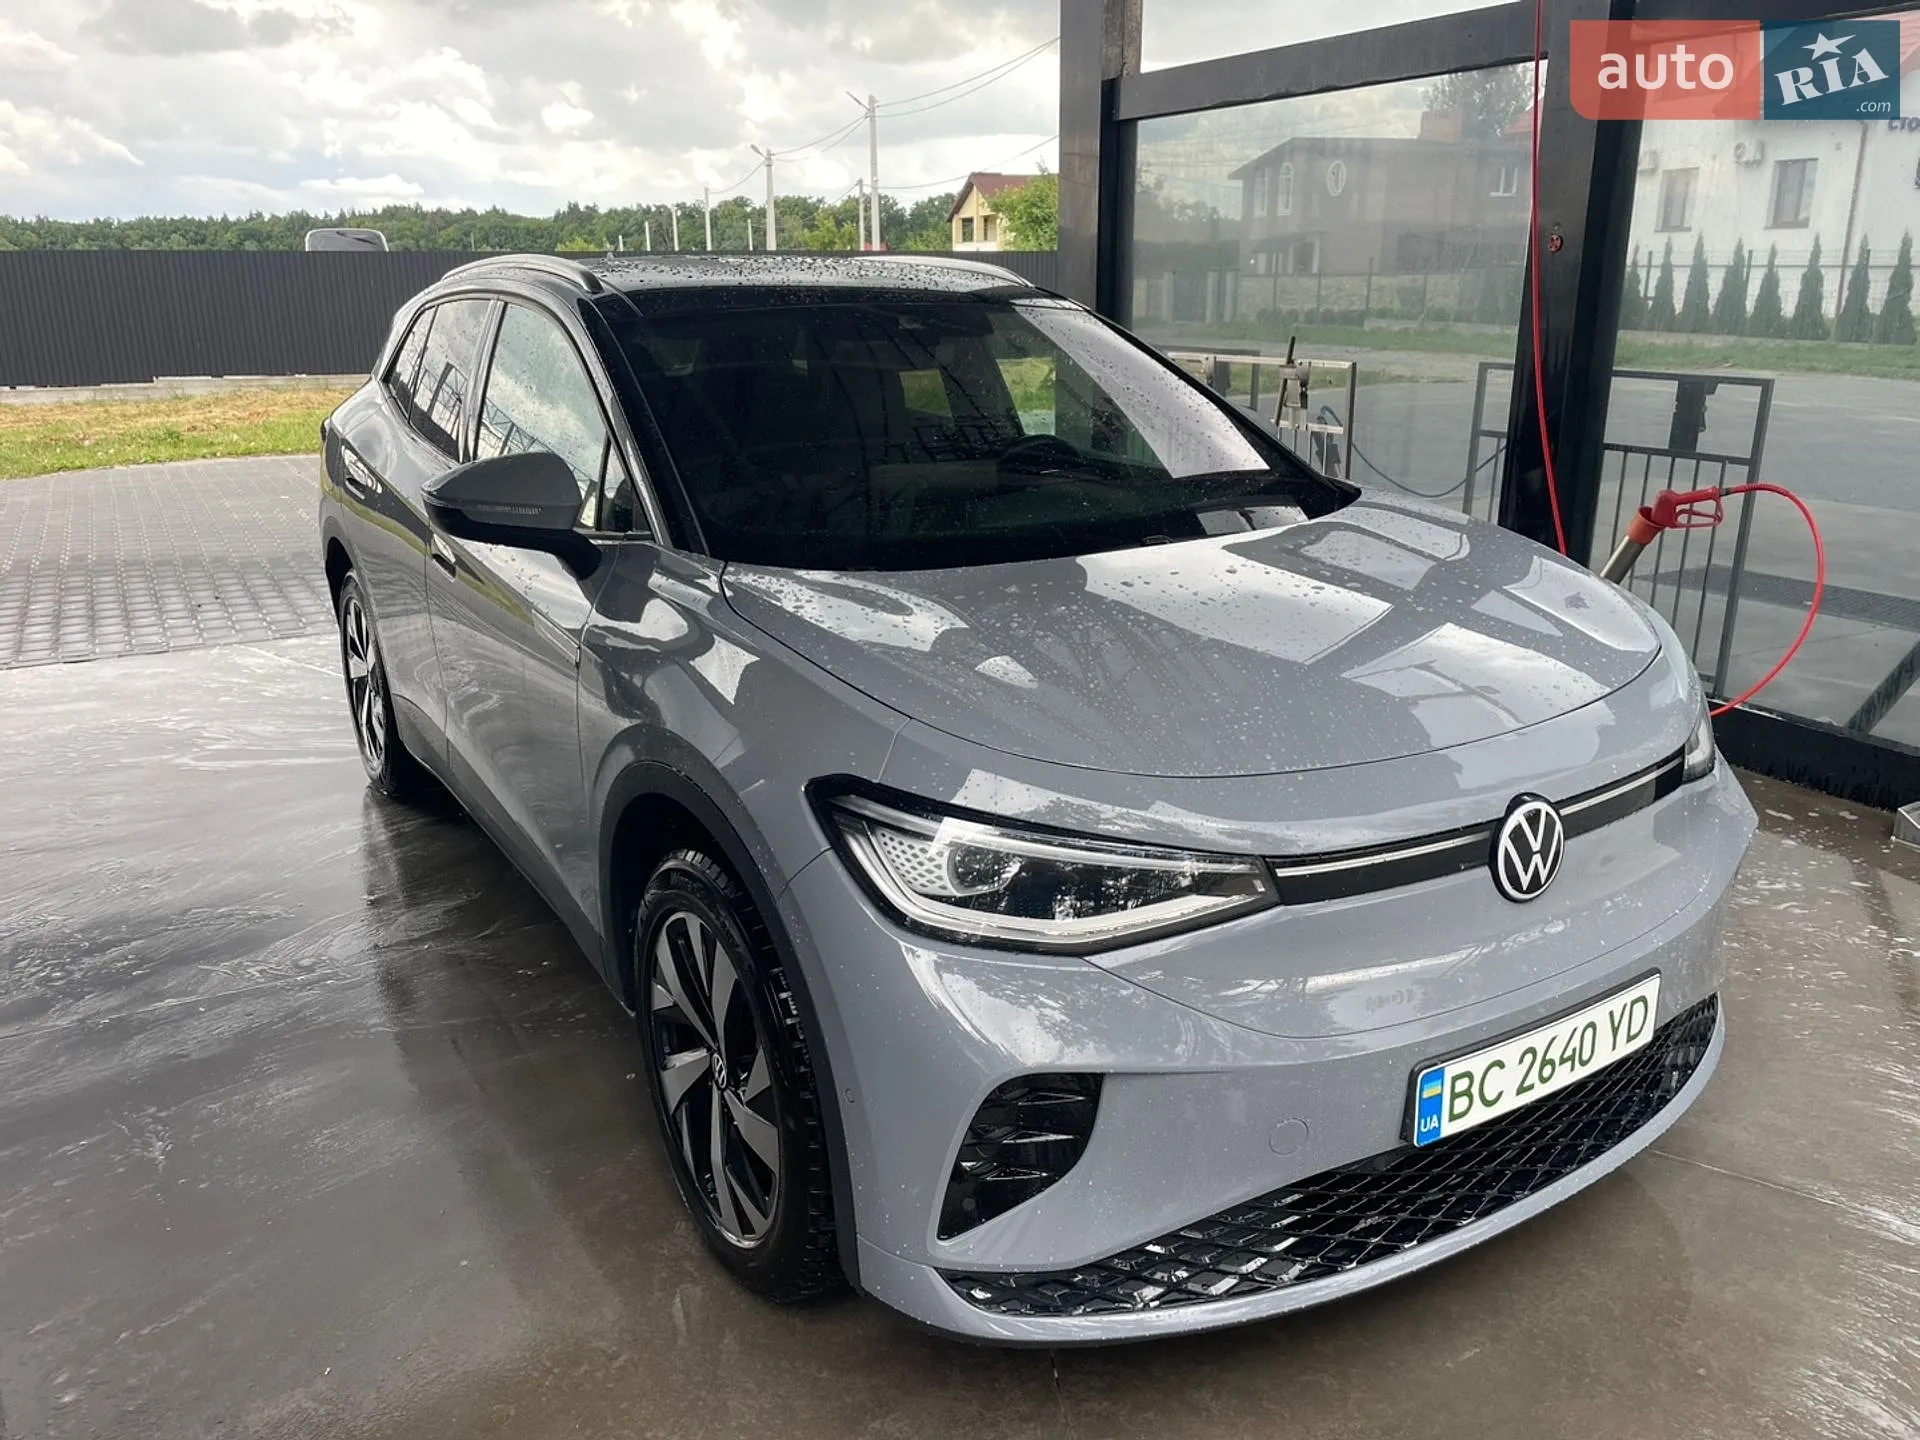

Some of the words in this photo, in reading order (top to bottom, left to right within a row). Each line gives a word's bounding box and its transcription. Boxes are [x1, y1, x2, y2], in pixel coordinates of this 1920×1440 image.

[1448, 1059, 1506, 1123] BC
[1515, 1020, 1598, 1097] 2640
[1608, 994, 1649, 1053] YD
[1420, 1113, 1440, 1133] UA
